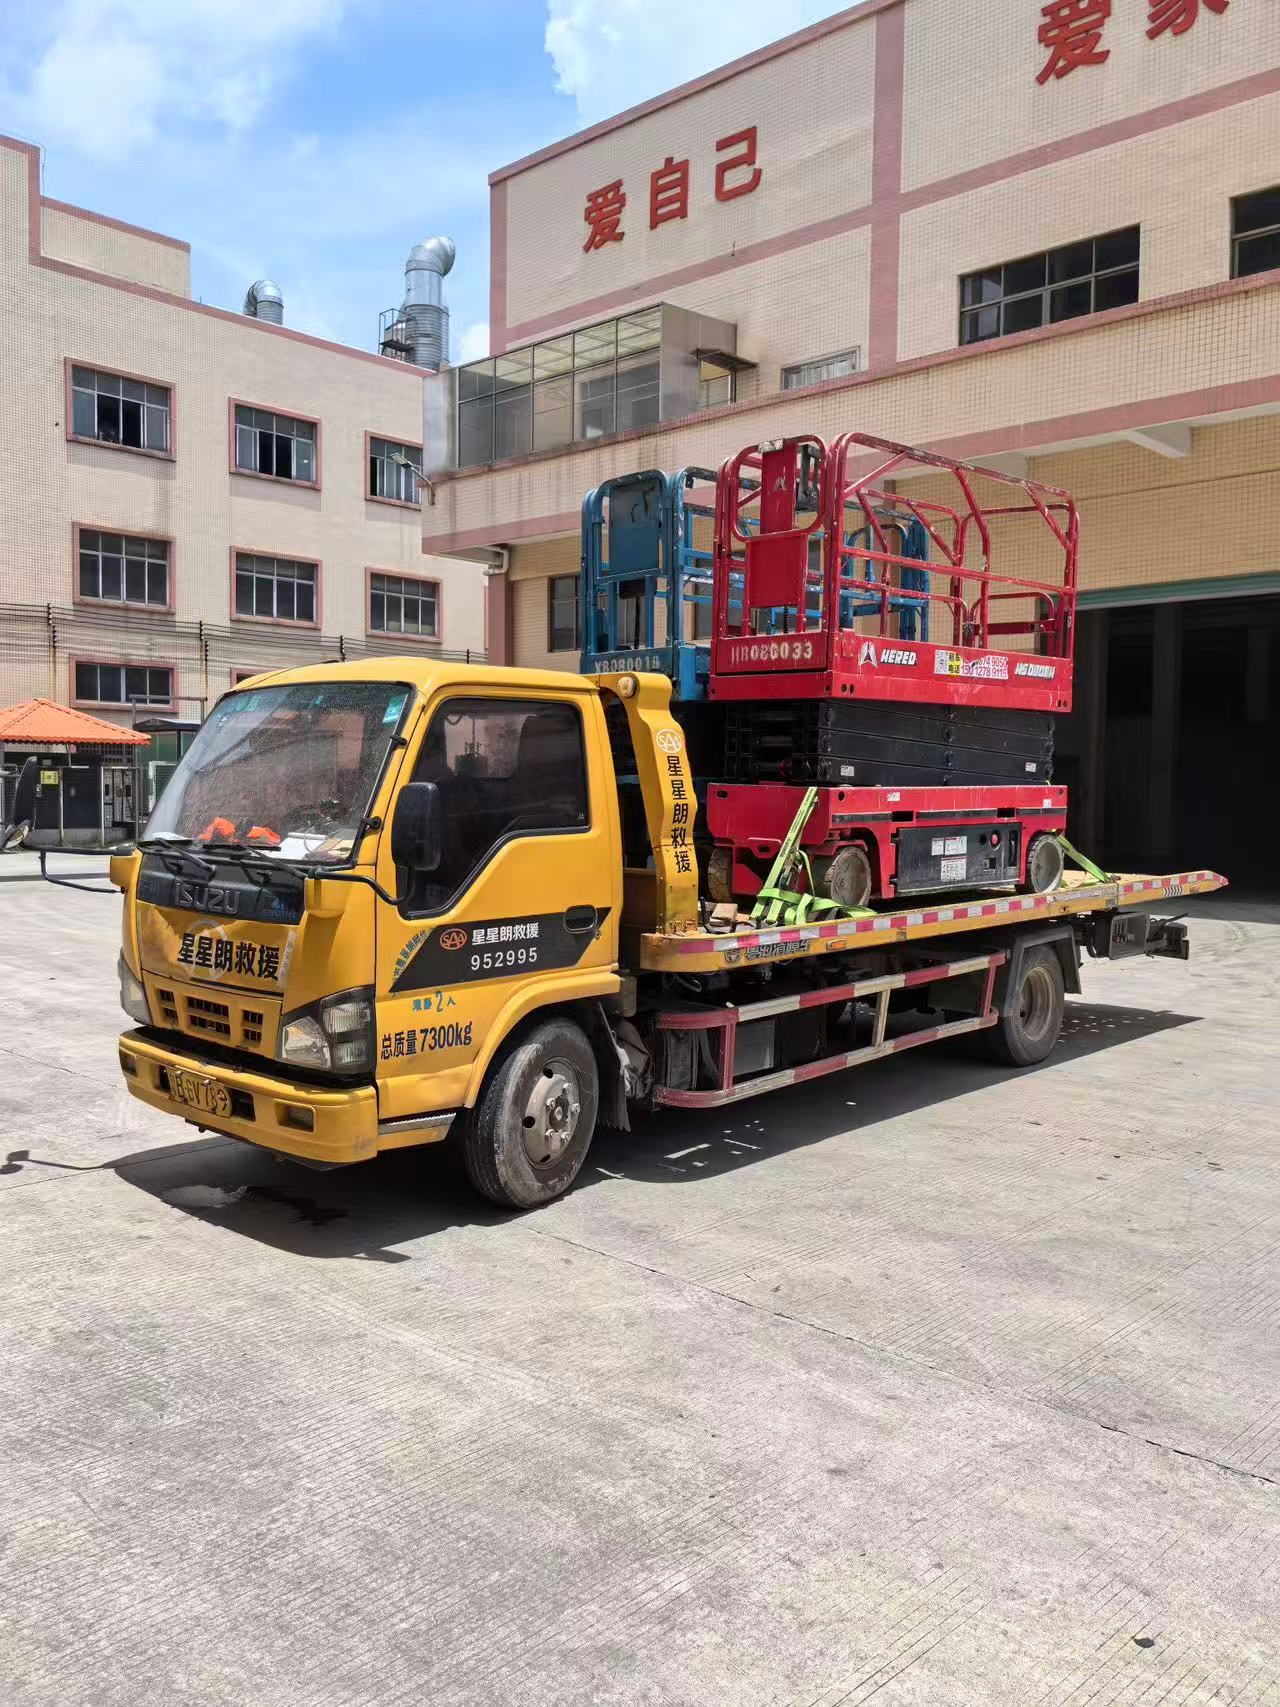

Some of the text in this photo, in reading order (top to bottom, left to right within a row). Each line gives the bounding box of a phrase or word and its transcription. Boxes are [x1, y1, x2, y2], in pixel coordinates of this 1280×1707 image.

[583, 126, 763, 254] 爱自己
[881, 649, 917, 666] HERED
[667, 755, 692, 873] 星星朗救援
[175, 878, 240, 915] ISUZU
[471, 922, 540, 946] 星星朗救援
[177, 932, 280, 981] 星星朗救援
[470, 947, 538, 971] 952995
